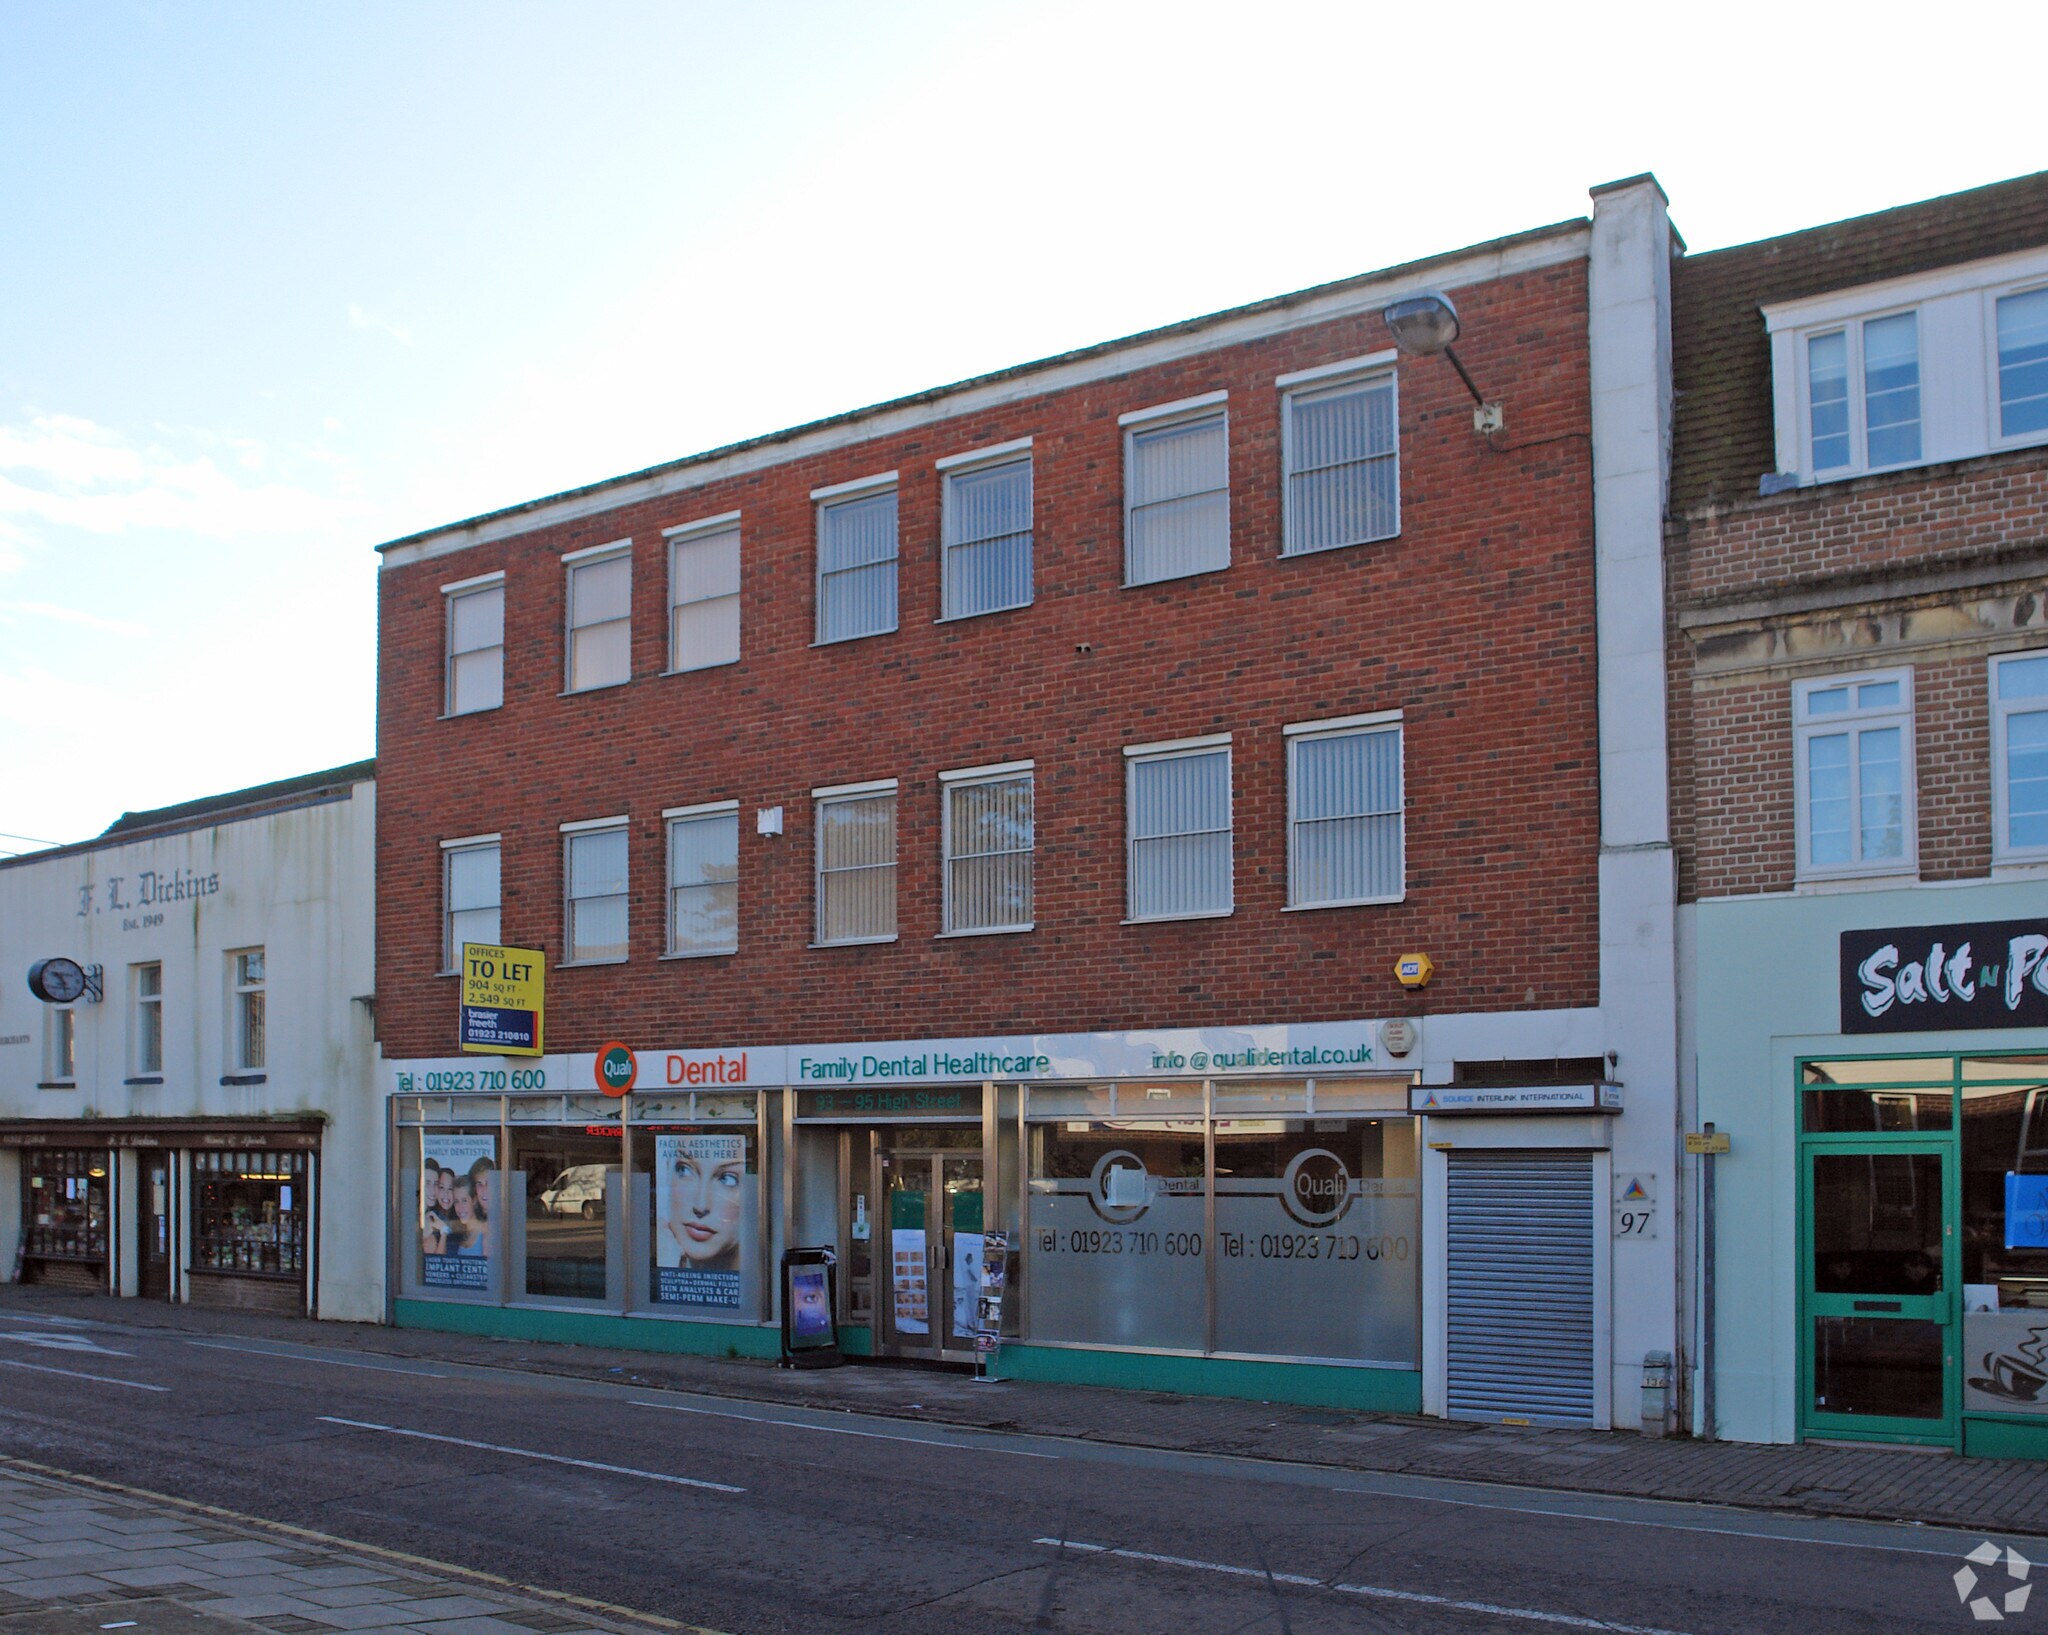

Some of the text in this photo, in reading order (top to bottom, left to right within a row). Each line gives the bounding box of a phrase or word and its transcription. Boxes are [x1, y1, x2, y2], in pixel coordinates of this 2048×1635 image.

[138, 868, 219, 905] Dickins
[143, 913, 164, 928] 1949
[469, 947, 505, 959] OFFICES
[469, 959, 532, 982] TO LET
[469, 980, 490, 990] 904
[493, 983, 504, 993] SQ
[507, 985, 516, 993] FT
[1858, 943, 1976, 1018] Salt
[1979, 965, 2000, 988] N
[503, 999, 514, 1007] SQ
[517, 999, 526, 1007] FT
[468, 1008, 499, 1020] brasier
[468, 1019, 498, 1029] freeth
[468, 1028, 496, 1039] 01923
[1152, 1051, 1186, 1069] info
[1212, 1044, 1374, 1071] qualidental.co.uk
[667, 1052, 747, 1084] Dental
[800, 1051, 1050, 1082] Family Dental Healthcare
[425, 1071, 474, 1091] 01923
[479, 1070, 506, 1090] 710
[512, 1069, 546, 1089] 600
[815, 1095, 834, 1111] 93
[855, 1093, 874, 1110] 95
[878, 1093, 911, 1112] High
[915, 1093, 961, 1109] Street
[1443, 1092, 1584, 1103] SOURCE INTERLINK INTERNATIONAL
[659, 1139, 741, 1149] FACIAL AESTHETICS
[450, 1148, 490, 1156] DENTISTRY
[663, 1150, 737, 1159] AVAILABLE HERE
[1158, 1179, 1199, 1191] Dental
[1297, 1172, 1343, 1199] Quali
[1621, 1213, 1650, 1234] 97
[1071, 1231, 1123, 1253] 01923
[1129, 1232, 1158, 1255] 710
[1165, 1232, 1202, 1256] 600
[1260, 1234, 1319, 1258] 01923
[1326, 1236, 1360, 1260] 710
[1366, 1237, 1408, 1261] 600
[426, 1263, 459, 1271] IMPLANT
[680, 1286, 714, 1294] ANALYSIS
[661, 1293, 703, 1302] SEMI-PERM
